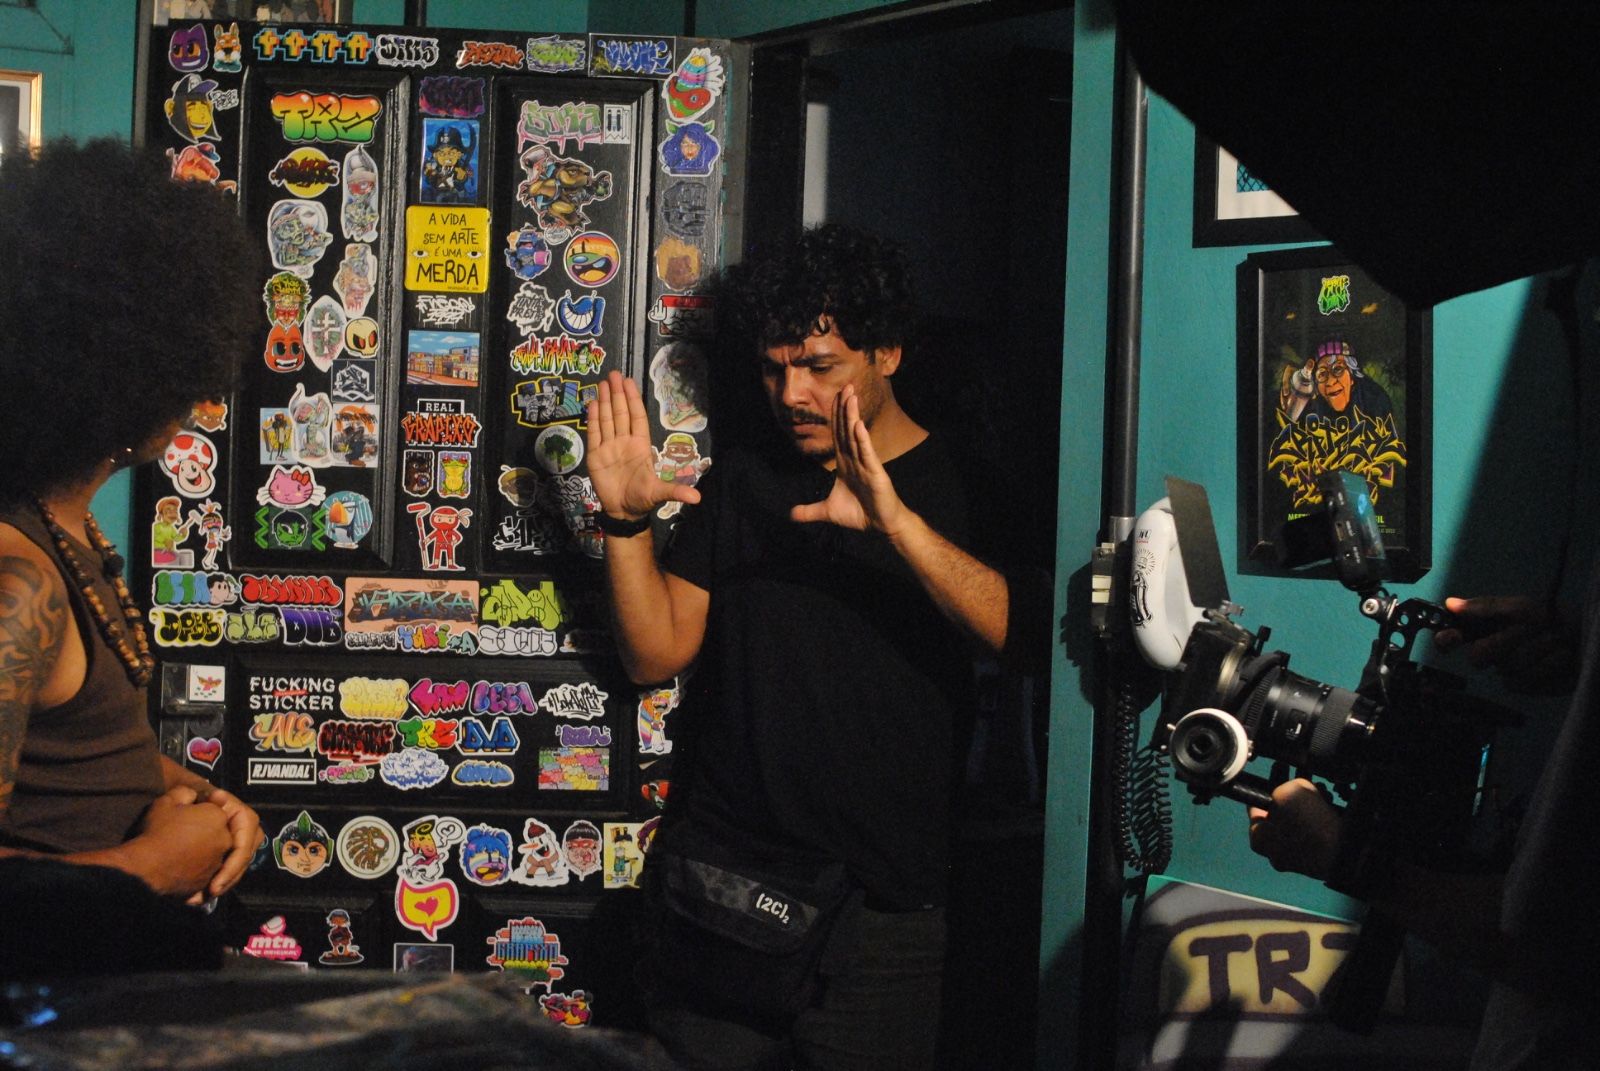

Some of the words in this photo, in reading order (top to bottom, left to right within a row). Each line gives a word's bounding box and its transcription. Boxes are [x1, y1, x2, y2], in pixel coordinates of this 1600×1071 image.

[429, 212, 436, 225] A
[441, 213, 467, 226] VIDA
[423, 233, 445, 245] SEM
[450, 228, 479, 245] ARTE
[443, 248, 462, 257] UMA
[416, 260, 479, 285] MERDA
[425, 402, 455, 412] REAL
[249, 677, 336, 693] FUCKING
[249, 696, 334, 710] STICKER
[251, 935, 297, 949] mtn
[1188, 930, 1360, 1009] TR
